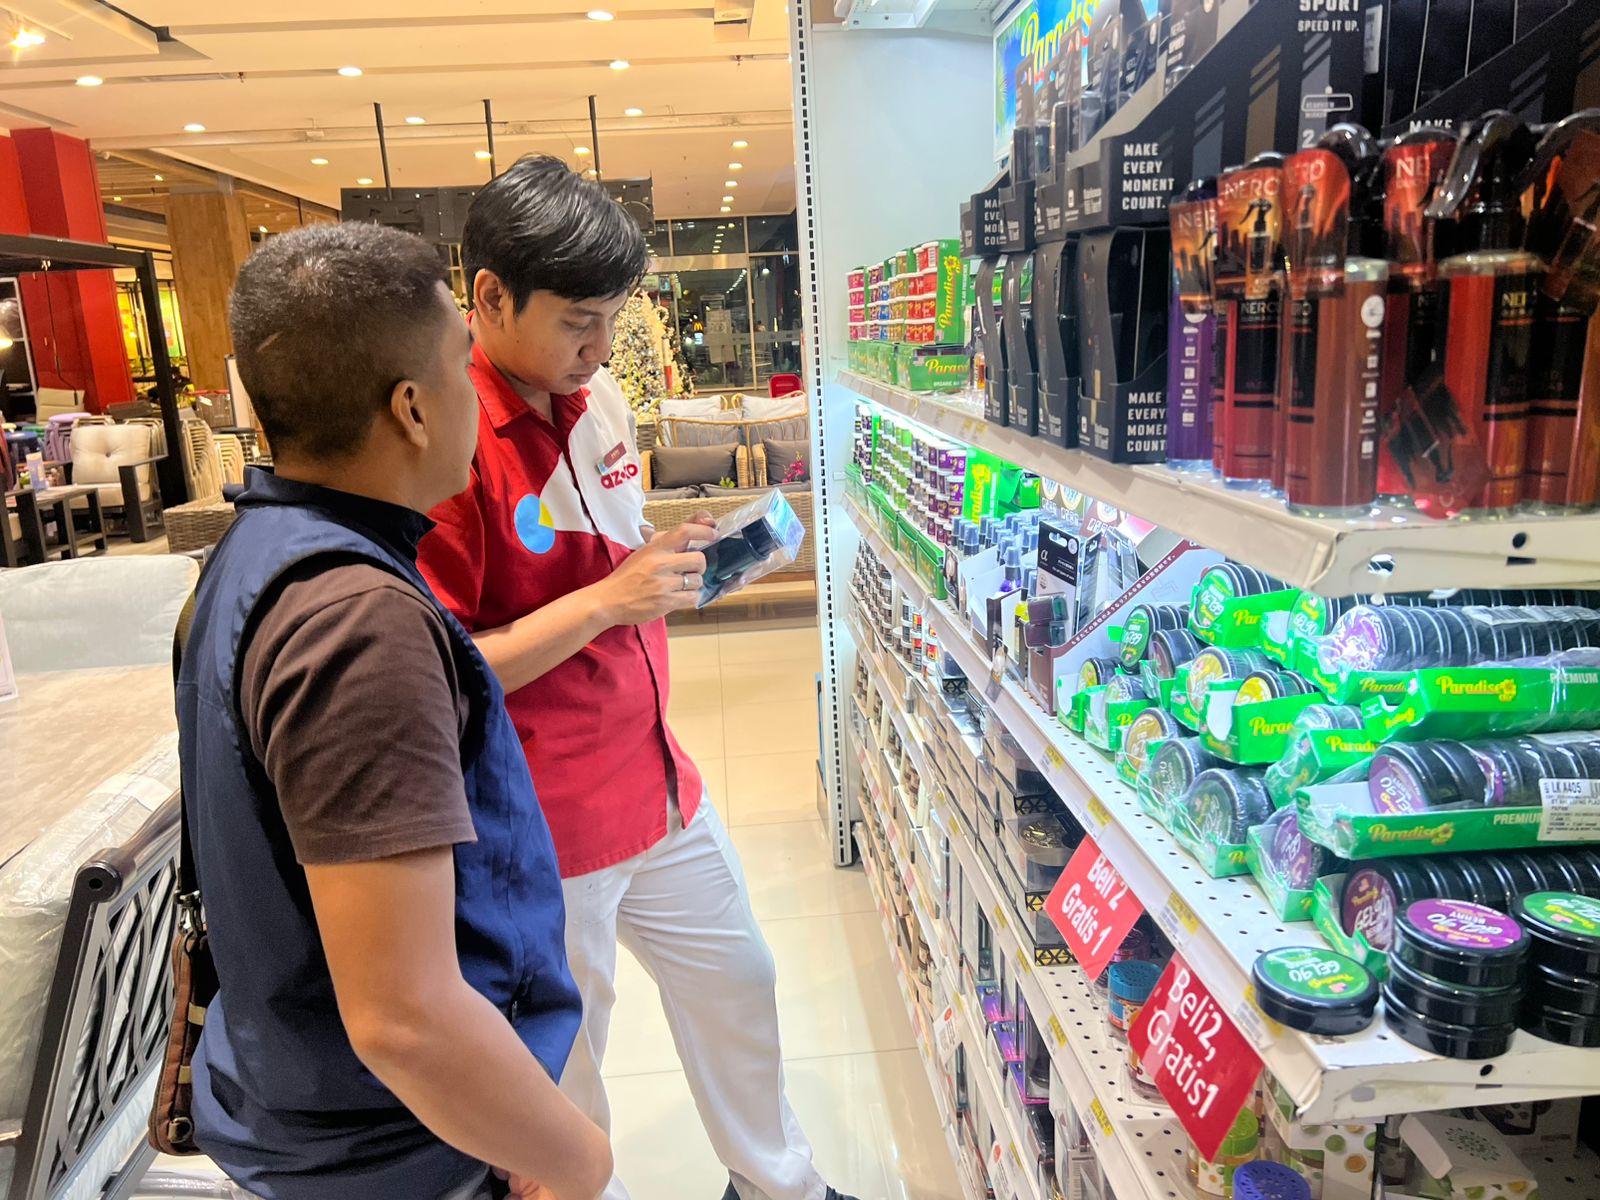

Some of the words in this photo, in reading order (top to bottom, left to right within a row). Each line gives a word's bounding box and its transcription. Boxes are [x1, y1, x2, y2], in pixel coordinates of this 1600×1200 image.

[1297, 20, 1330, 32] SPEED
[1332, 20, 1343, 32] IT
[1345, 20, 1360, 32] UP.
[1124, 143, 1159, 157] MAKE
[1123, 161, 1163, 175] EVERY
[1122, 178, 1175, 193] MOMENT
[1122, 197, 1167, 210] COUNT.
[1128, 391, 1162, 405] MAKE
[1128, 408, 1166, 421] EVERY
[1436, 675, 1501, 694] Paradise
[1367, 823, 1437, 842] Paradise
[1087, 854, 1114, 899] Beli
[1110, 881, 1128, 911] 2
[1061, 883, 1099, 945] Gratis
[1091, 925, 1113, 956] 1
